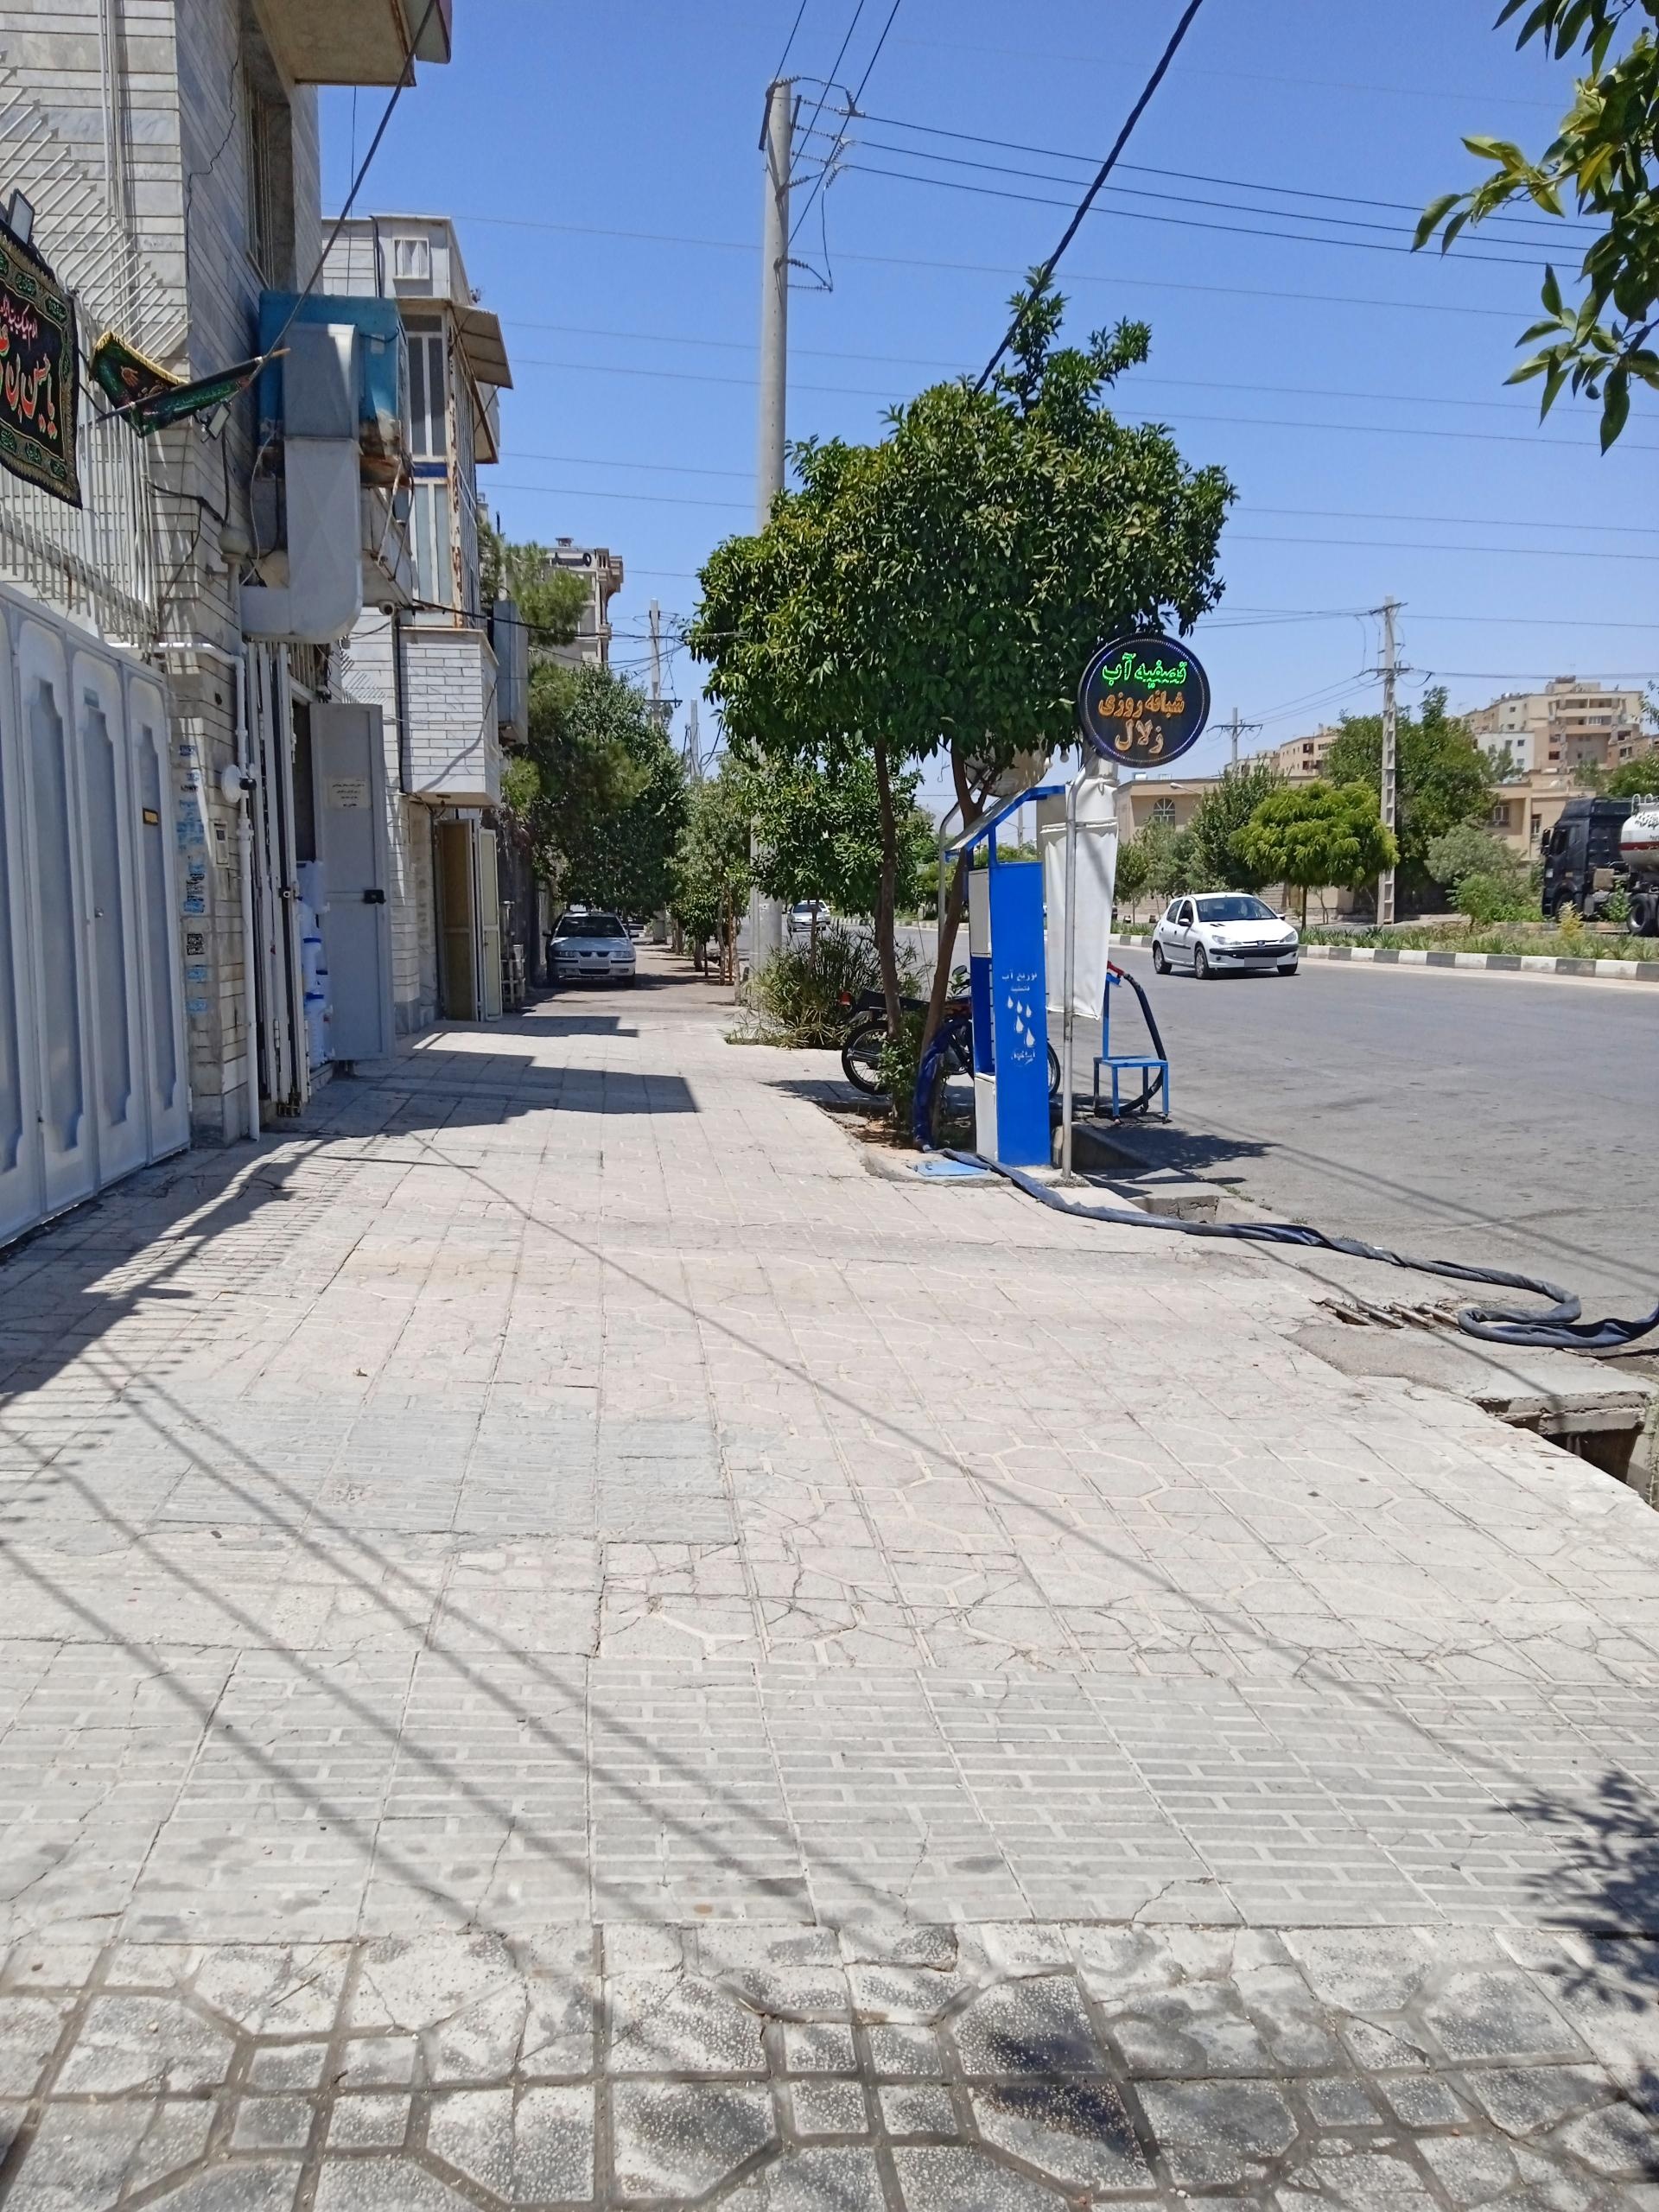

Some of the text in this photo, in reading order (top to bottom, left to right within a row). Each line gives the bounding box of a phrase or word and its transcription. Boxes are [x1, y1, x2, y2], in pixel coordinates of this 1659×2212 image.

[1102, 652, 1188, 690] تصفیه آب
[1098, 690, 1185, 718] شبانه روزی
[1115, 719, 1164, 753] زلال
